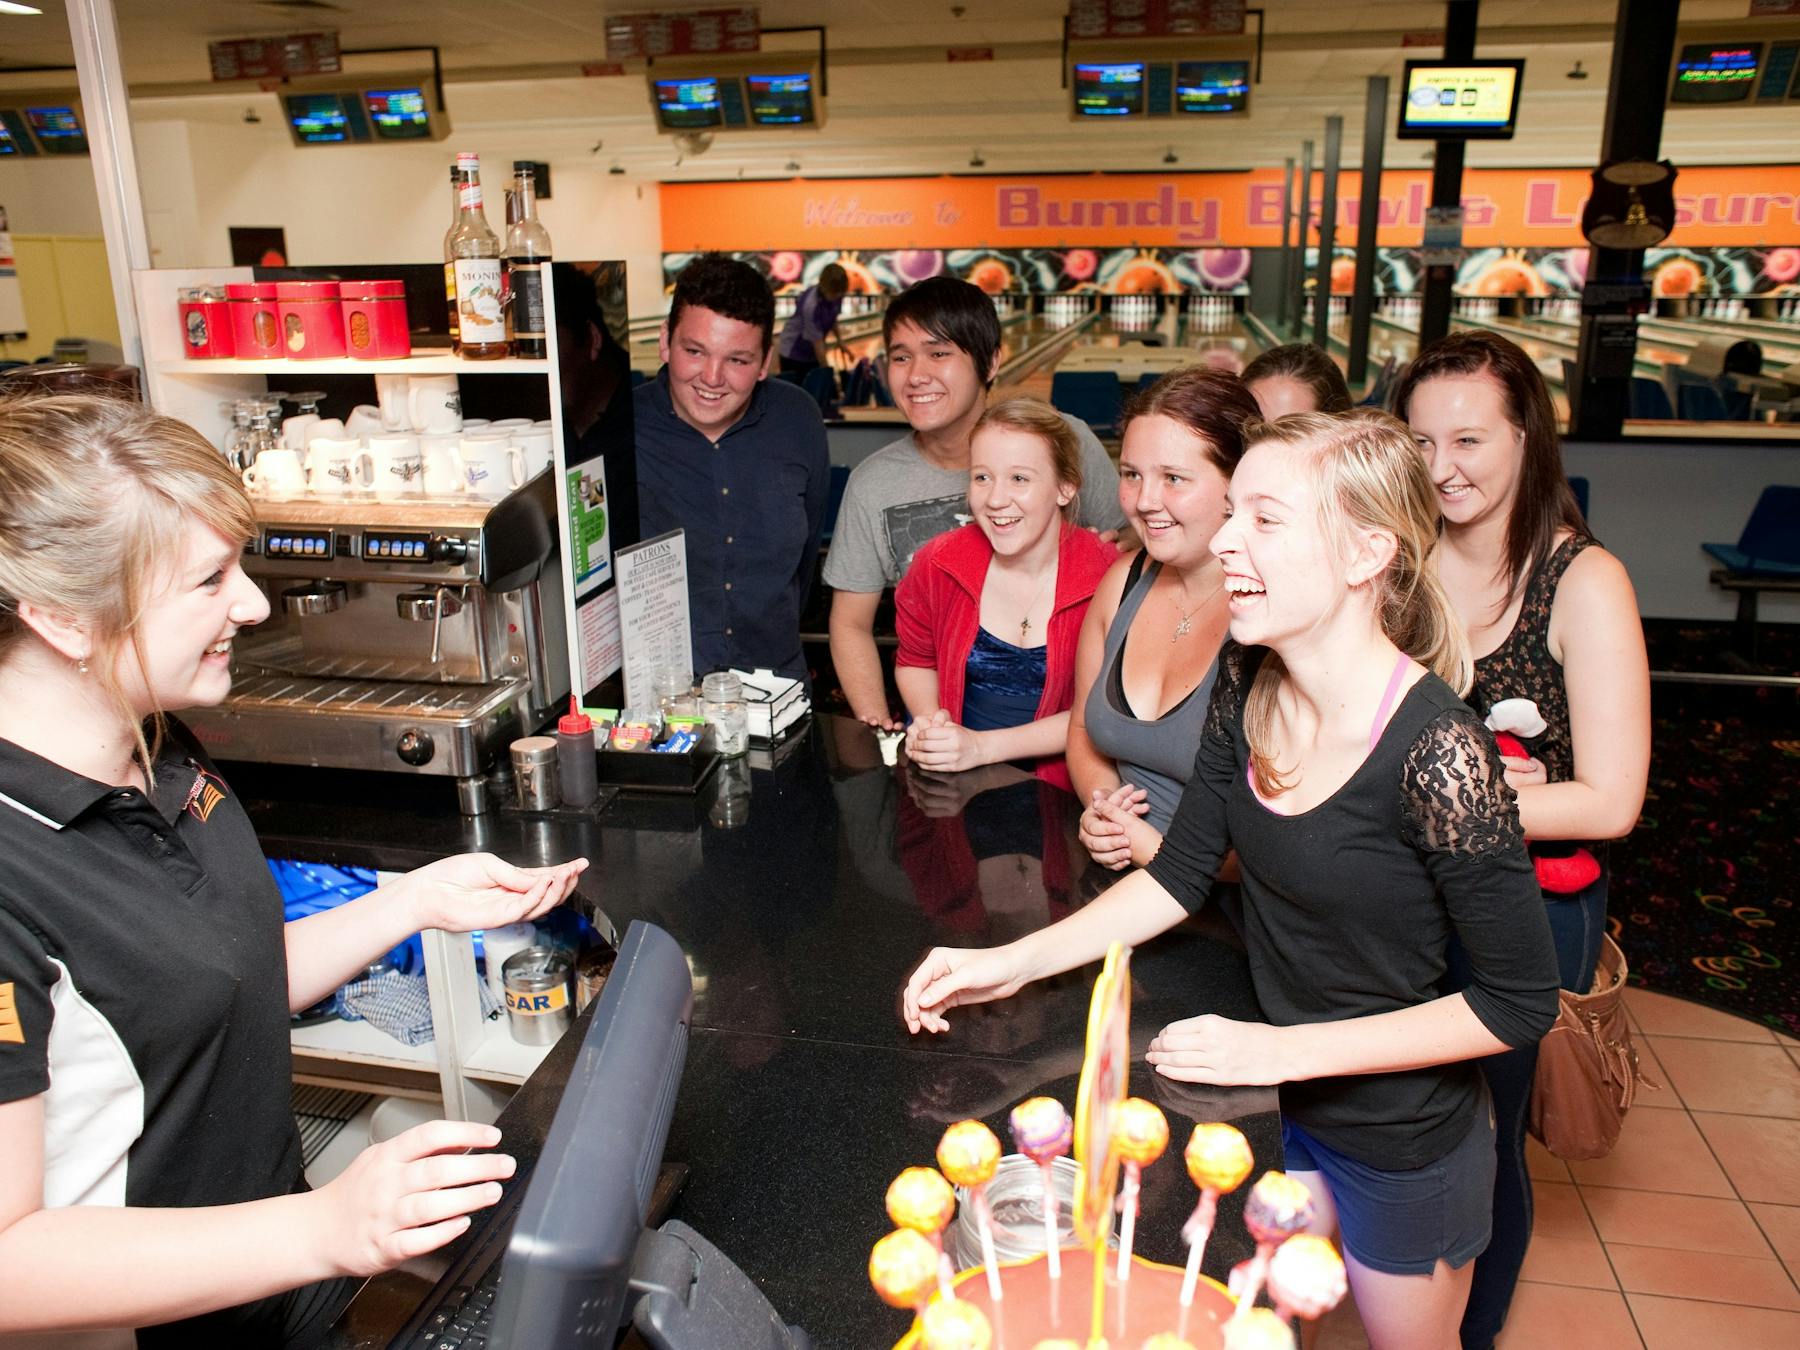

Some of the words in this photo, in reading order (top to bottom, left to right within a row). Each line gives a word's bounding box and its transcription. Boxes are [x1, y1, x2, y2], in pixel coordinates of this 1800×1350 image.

[803, 196, 912, 228] Welcome
[933, 200, 961, 226] to
[997, 185, 1220, 241] Bundy
[1525, 180, 1800, 228] Lsur
[461, 271, 501, 281] MONIN
[633, 542, 671, 565] PATRONS
[505, 992, 551, 1012] GAR
